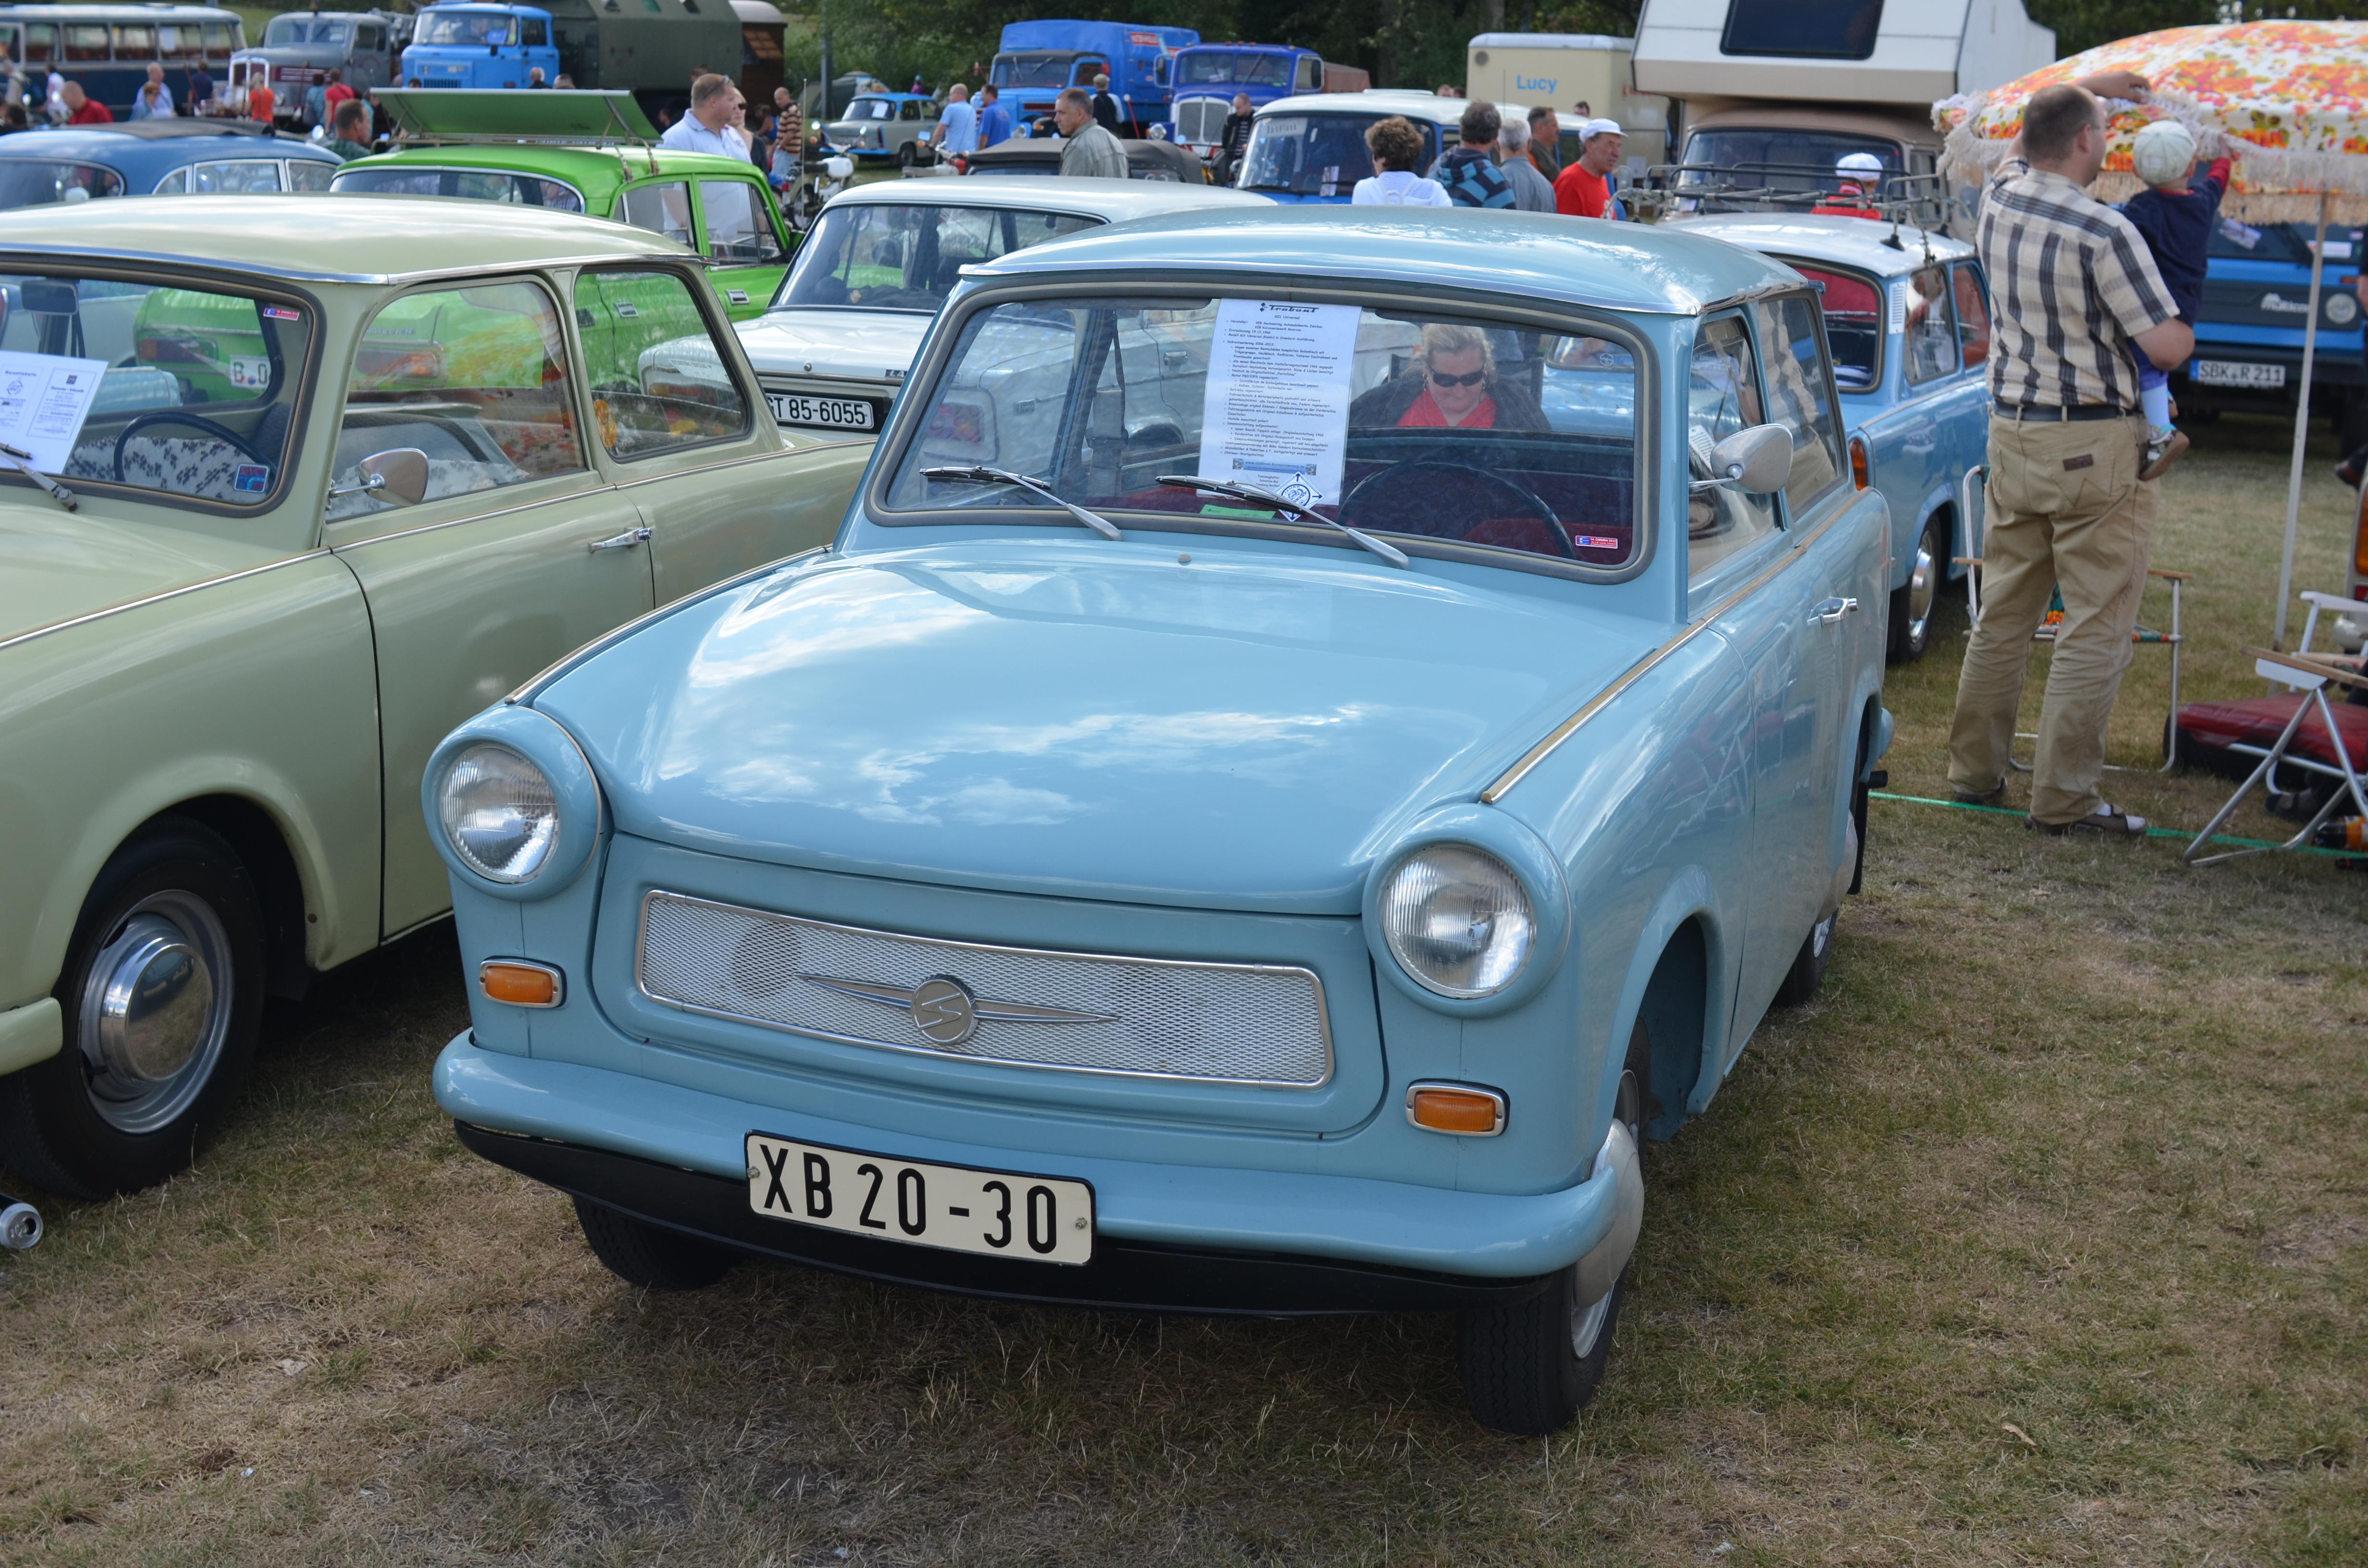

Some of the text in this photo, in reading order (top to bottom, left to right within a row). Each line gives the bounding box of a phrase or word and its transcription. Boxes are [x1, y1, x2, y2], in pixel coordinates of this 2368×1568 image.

[1517, 74, 1557, 95] Lucy
[1268, 304, 1319, 313] Trabant
[2200, 364, 2282, 381] SBK R 211
[789, 399, 866, 425] 85-6055
[760, 1144, 833, 1219] XB
